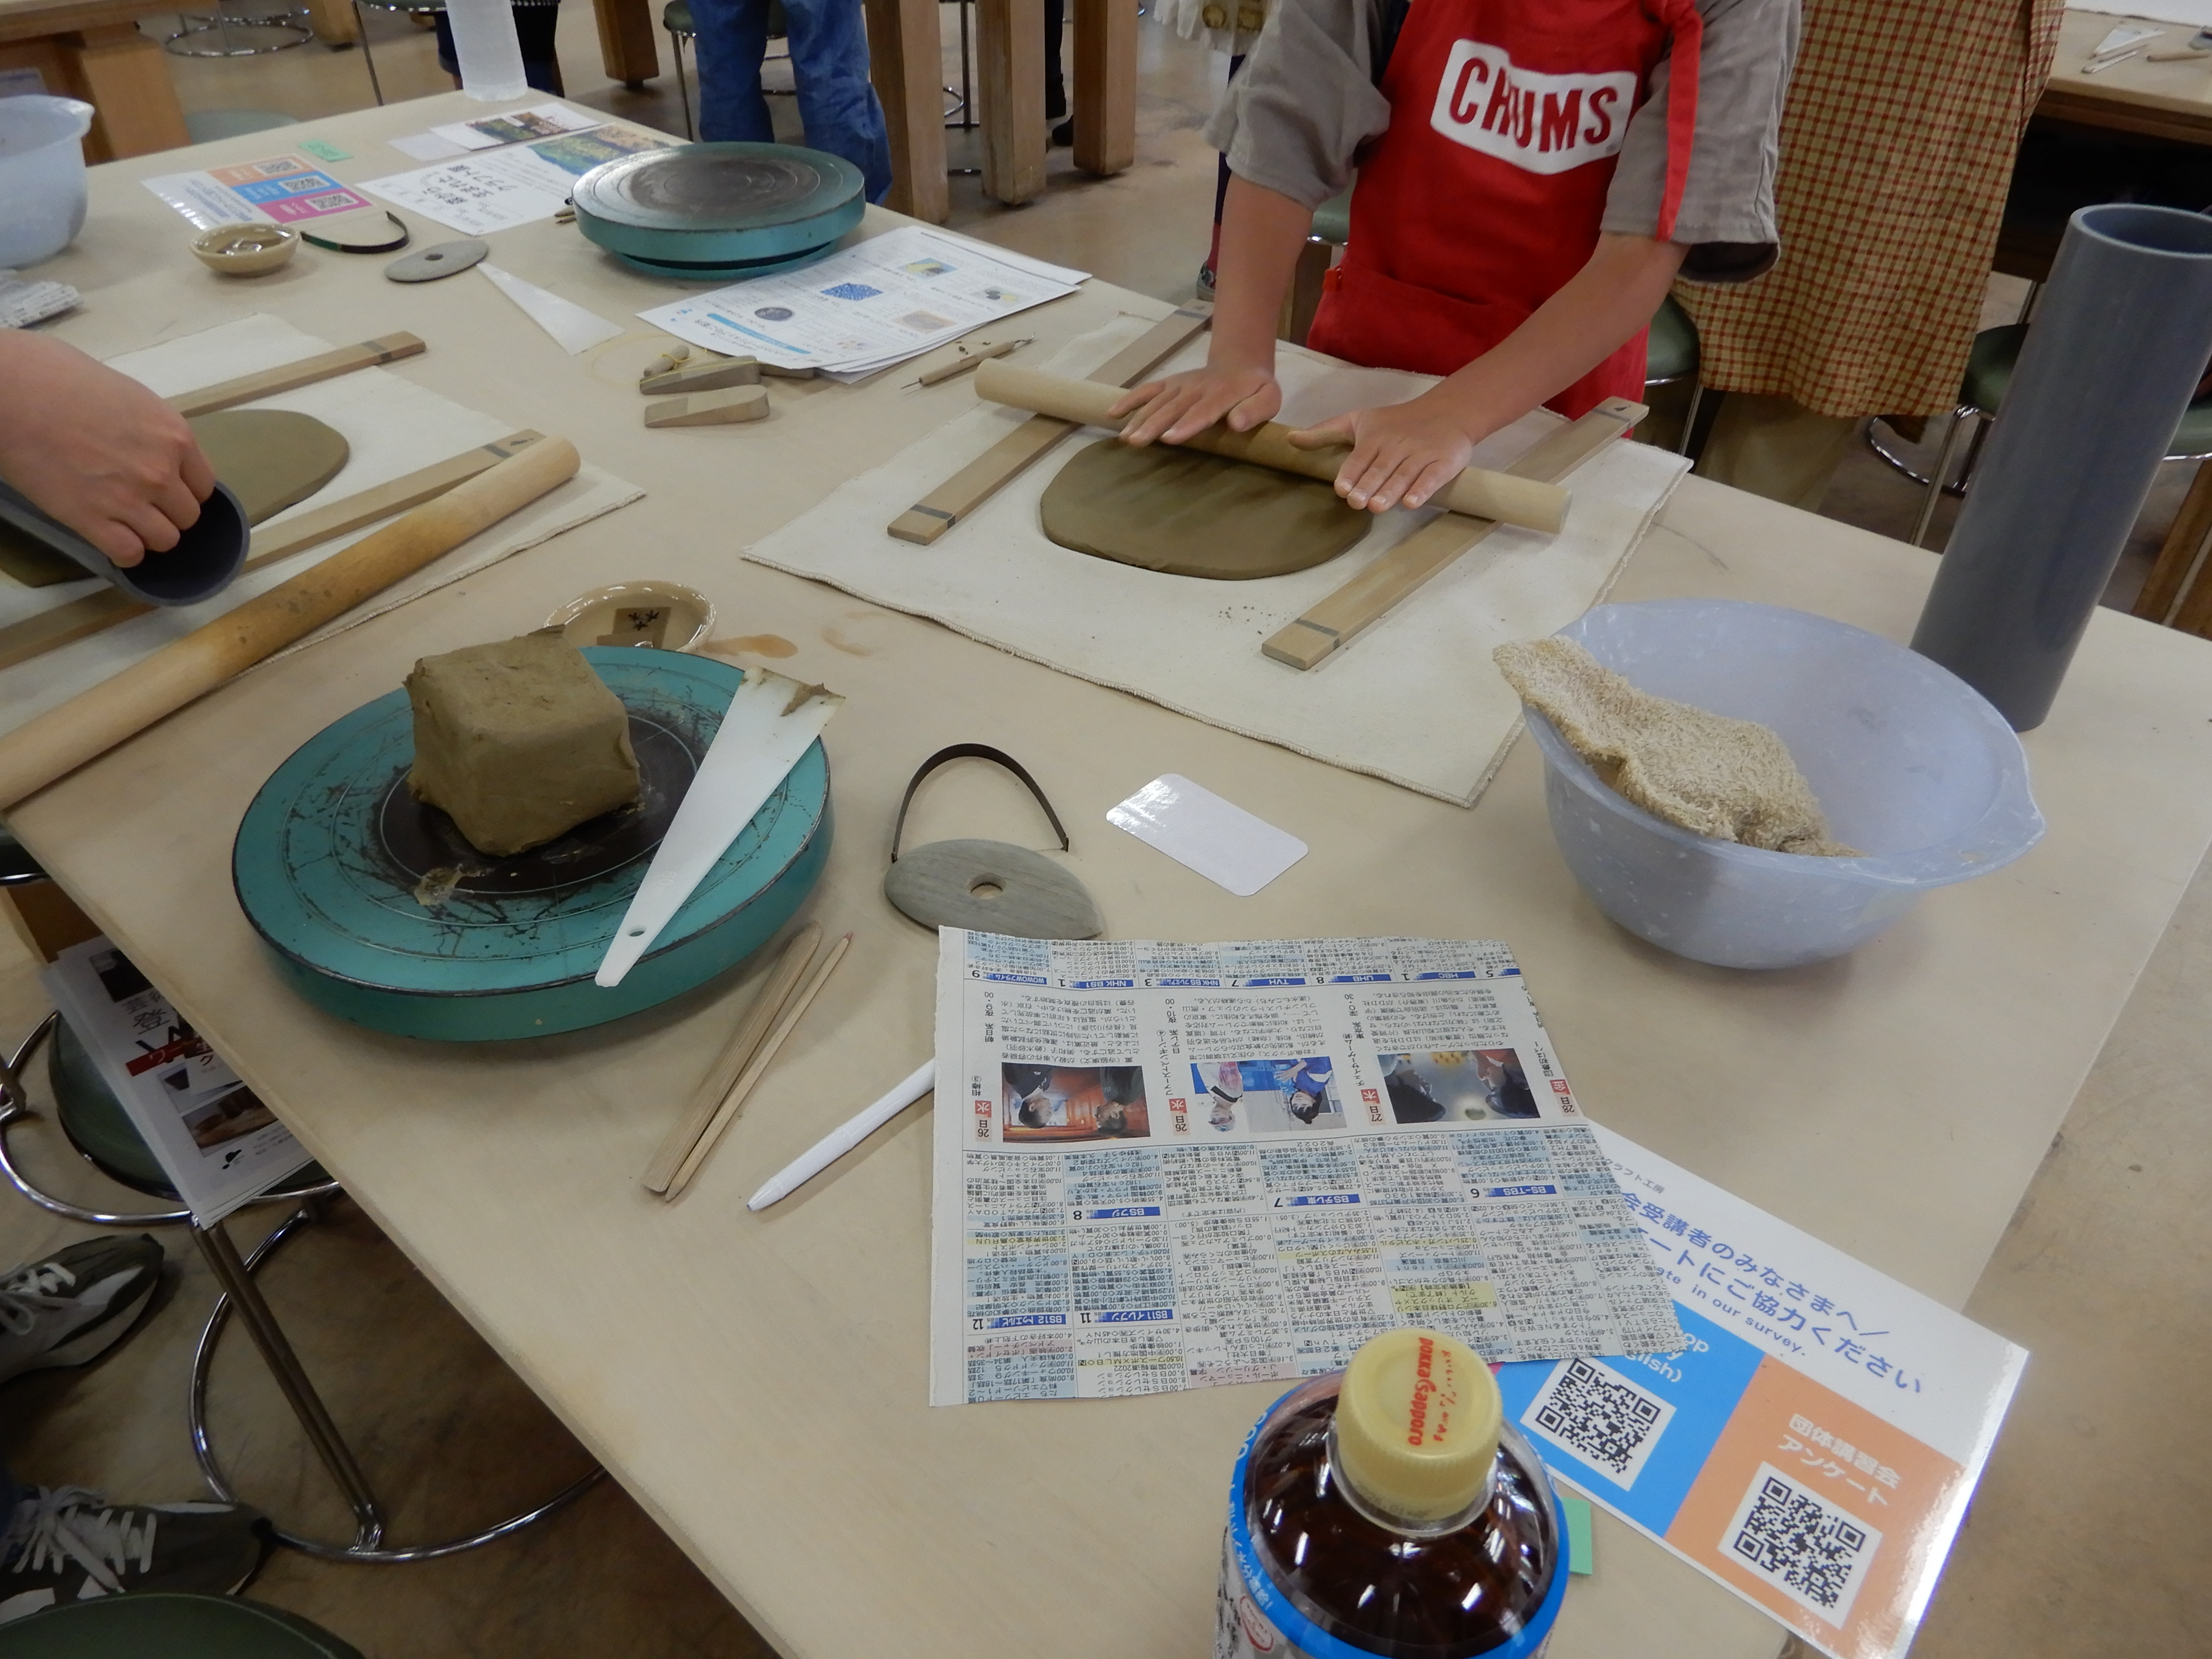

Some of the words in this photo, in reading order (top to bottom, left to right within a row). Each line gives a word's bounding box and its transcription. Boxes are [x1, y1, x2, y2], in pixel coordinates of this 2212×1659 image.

[1449, 58, 1618, 153] CHUMS
[995, 974, 1044, 983] WOWOWプライム
[1021, 995, 1134, 1005] 谷豊）は独自の捜査を開始する。
[1193, 995, 1311, 1003] （速水もこみち）から連絡が入る。
[1001, 1001, 1135, 1013] いた。薫が逃亡を続ける中、右京（水
[1182, 1003, 1316, 1011] フレンチレストランのシェフ・流山
[134, 1008, 170, 1035] 登
[1001, 1010, 1136, 1022] というが、塩見は4年前に事故死して
[1185, 1017, 1320, 1028] 一）は、和佳に無断でクレーム対応を
[984, 1022, 994, 1042] 朝日系
[1001, 1026, 1138, 1038] に異動していた当時に世話になった塩
[1185, 1025, 1322, 1036] 目になり、大赤字になる。片岡（堤真
[1352, 1022, 1365, 1039] 東京系
[1001, 1035, 1139, 1046] によると、最近薫は、運転免許試験場
[1168, 1029, 1181, 1053] 日テレ系
[1186, 1033, 1324, 1044] が続出。和佳（奈緒）が代品を送る羽
[1005, 1044, 1139, 1054] として逃亡する。美和子（鈴木砂羽）
[1187, 1040, 1326, 1052] えるが、配送先の飲食店からクレーム
[1001, 1053, 1133, 1063] 薫（寺脇康文）が殺人事件の容疑者
[1189, 1048, 1316, 1060] 「お魚ボックス」の注文は順調に増
[971, 1075, 981, 1096] 相棒③
[1362, 1090, 1377, 1099] 木
[977, 1102, 989, 1112] 水
[1170, 1100, 1184, 1109] 水
[1558, 1097, 1575, 1112] 28日
[1368, 1106, 1382, 1121] 27日
[978, 1119, 989, 1137] 26日
[1173, 1115, 1187, 1131] 26日
[1470, 1188, 1481, 1198] 6
[1502, 1186, 1547, 1195] BS-TBS
[1272, 1198, 1283, 1207] 7
[1306, 1195, 1349, 1204] BSテレ東
[1073, 1210, 1082, 1220] 8
[1111, 1208, 1144, 1216] BSフジ
[1038, 1315, 1062, 1324] BS12
[1080, 1312, 1091, 1323] 11
[1111, 1311, 1145, 1321] イレブン
[1147, 1310, 1167, 1319] BS11
[972, 1318, 983, 1330] 12
[1001, 1316, 1033, 1326] トゥエルビ
[1691, 1284, 1707, 1300] in
[1712, 1298, 1741, 1319] our
[1745, 1315, 1806, 1357] survey.
[1199, 1371, 1278, 1382] ポール・ニューマン
[1789, 1413, 1901, 1489] 団体講習会
[1777, 1434, 1889, 1507] アンケート
